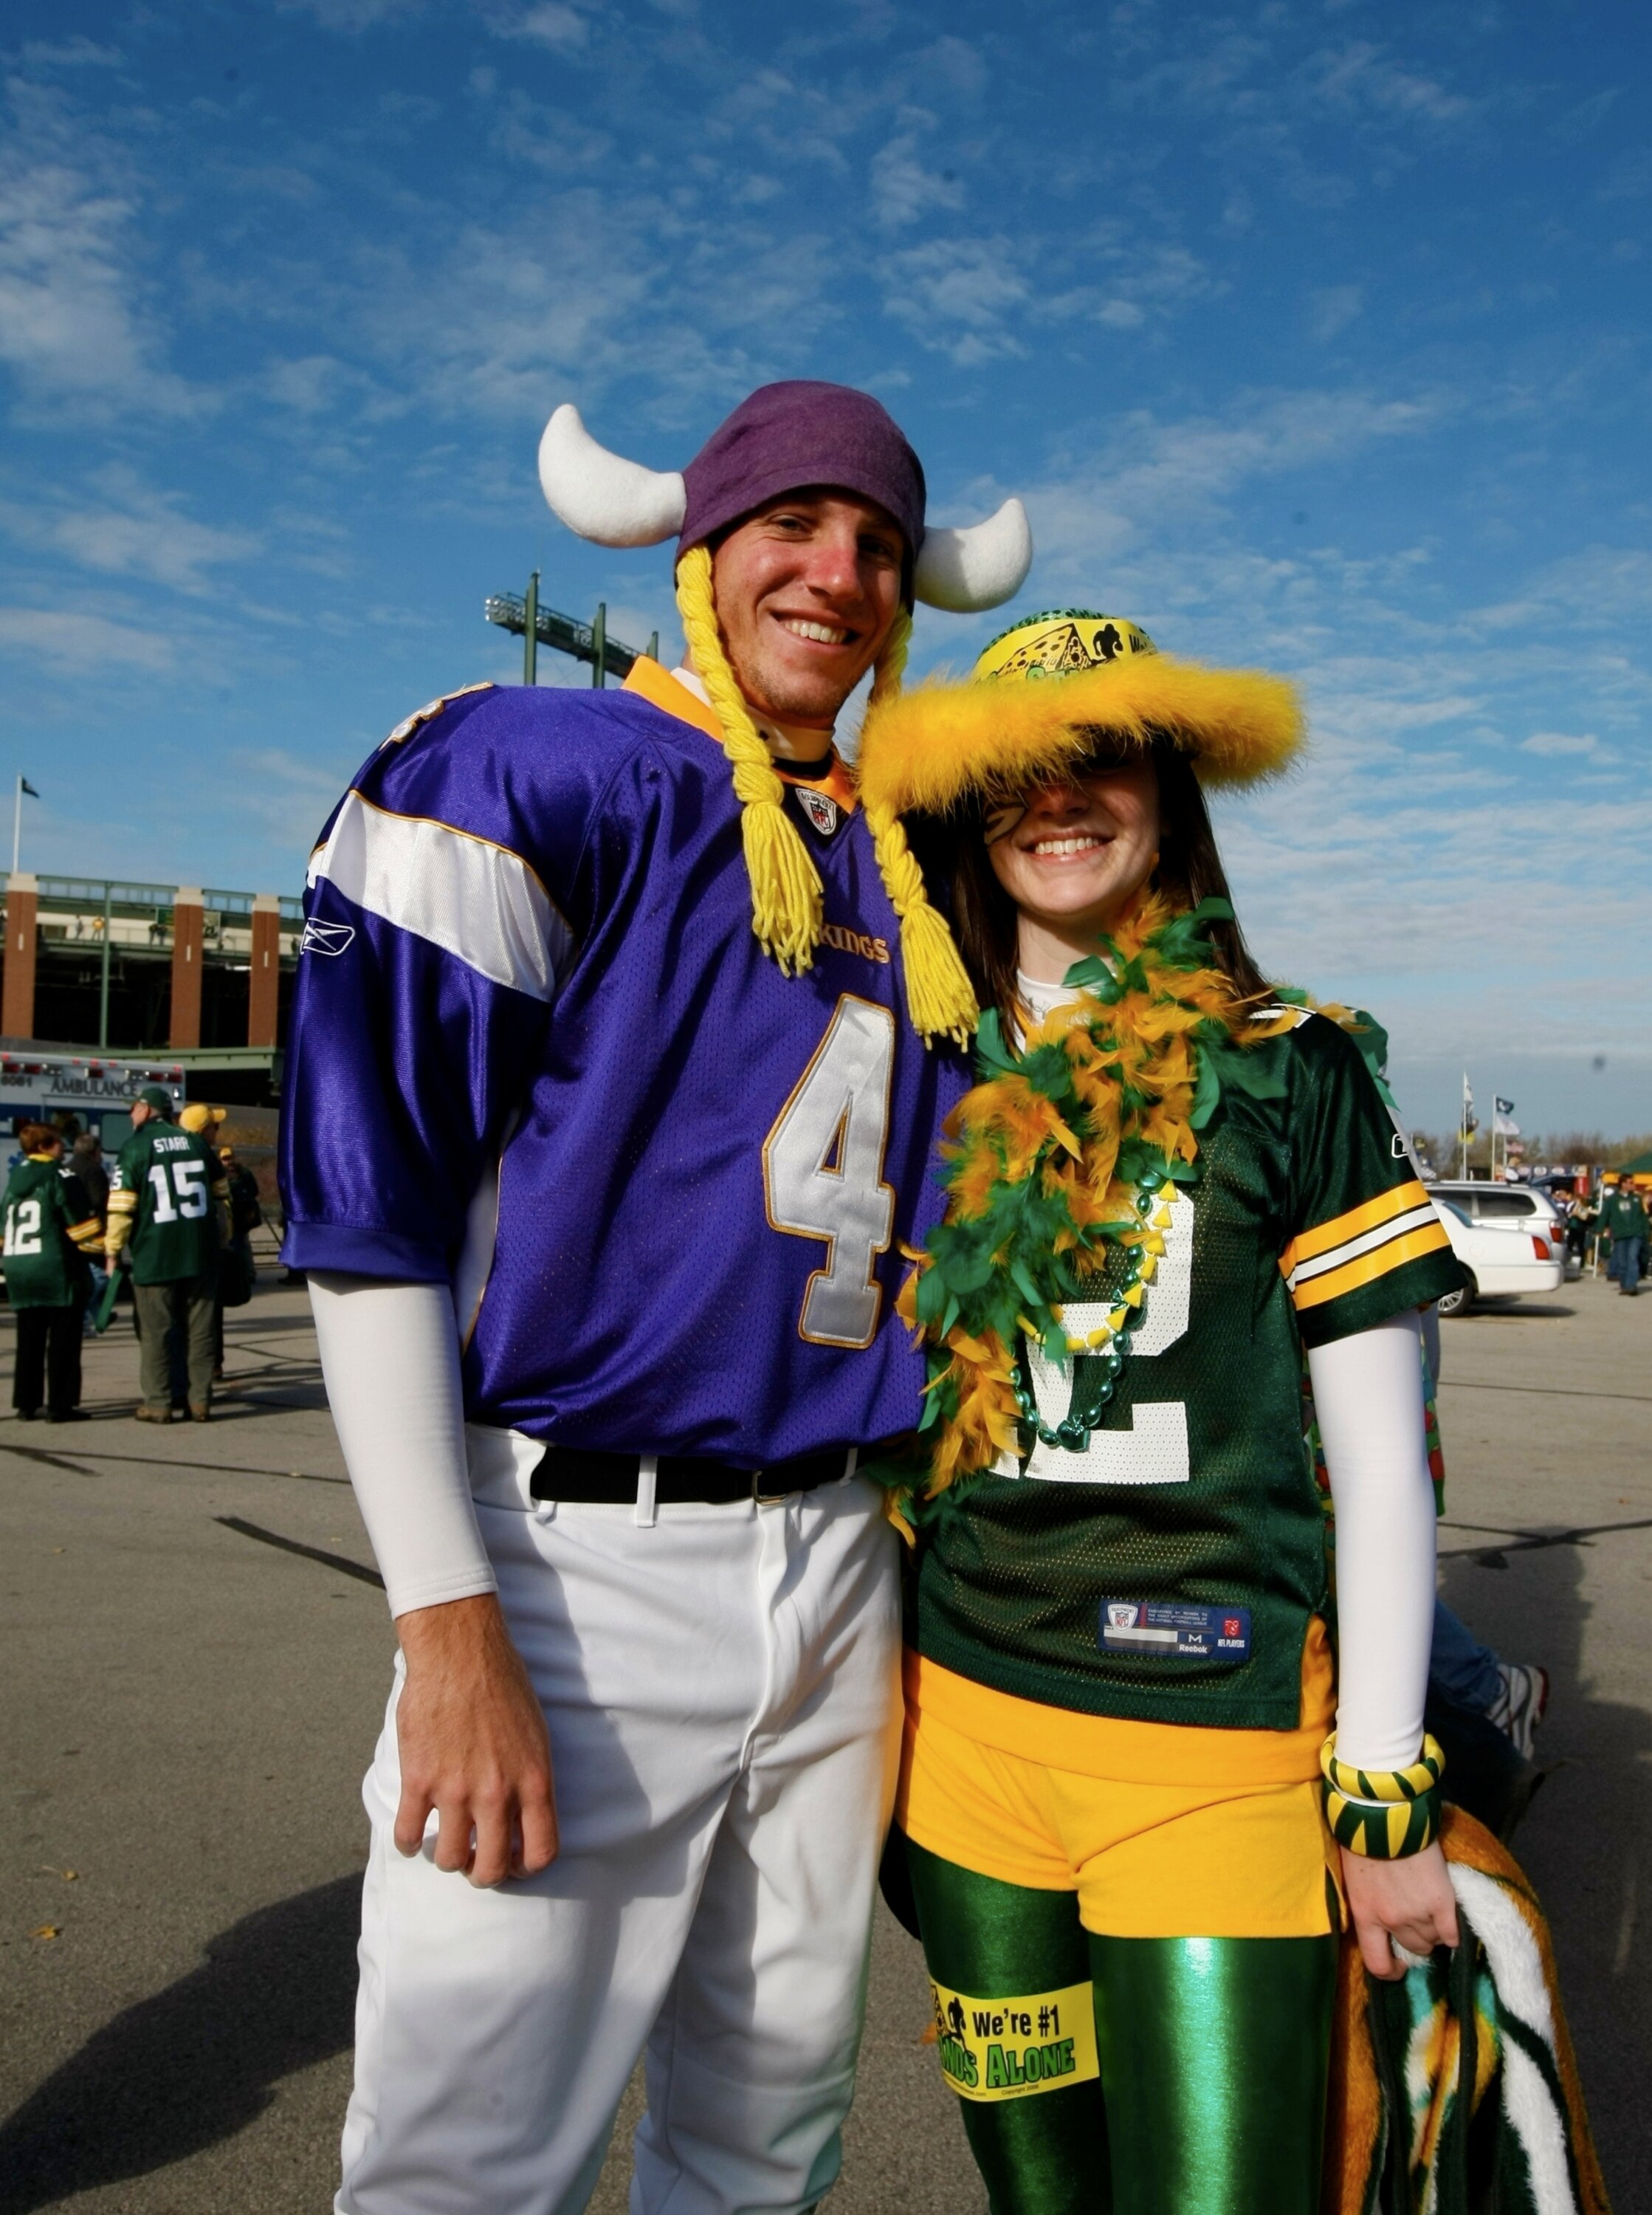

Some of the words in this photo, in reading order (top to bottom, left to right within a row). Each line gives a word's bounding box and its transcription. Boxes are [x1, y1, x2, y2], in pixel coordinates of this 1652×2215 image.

[819, 923, 890, 964] KINGS
[50, 1076, 138, 1096] AMBULANCE
[153, 1136, 190, 1153] STARR
[109, 1170, 124, 1191] 5
[761, 992, 896, 1349] 4
[148, 1159, 207, 1223] 15
[3, 1200, 42, 1256] 12
[988, 1180, 1191, 1485] 2
[1179, 1644, 1208, 1654] Reebok
[1188, 1634, 1202, 1644] M
[1217, 1638, 1226, 1647] NFL
[1226, 1638, 1245, 1648] PLAYERS
[972, 2008, 1032, 2038] We're
[1038, 2004, 1060, 2038] #1
[986, 2037, 1076, 2089] ALONE
[1001, 2087, 1026, 2096] Copyright
